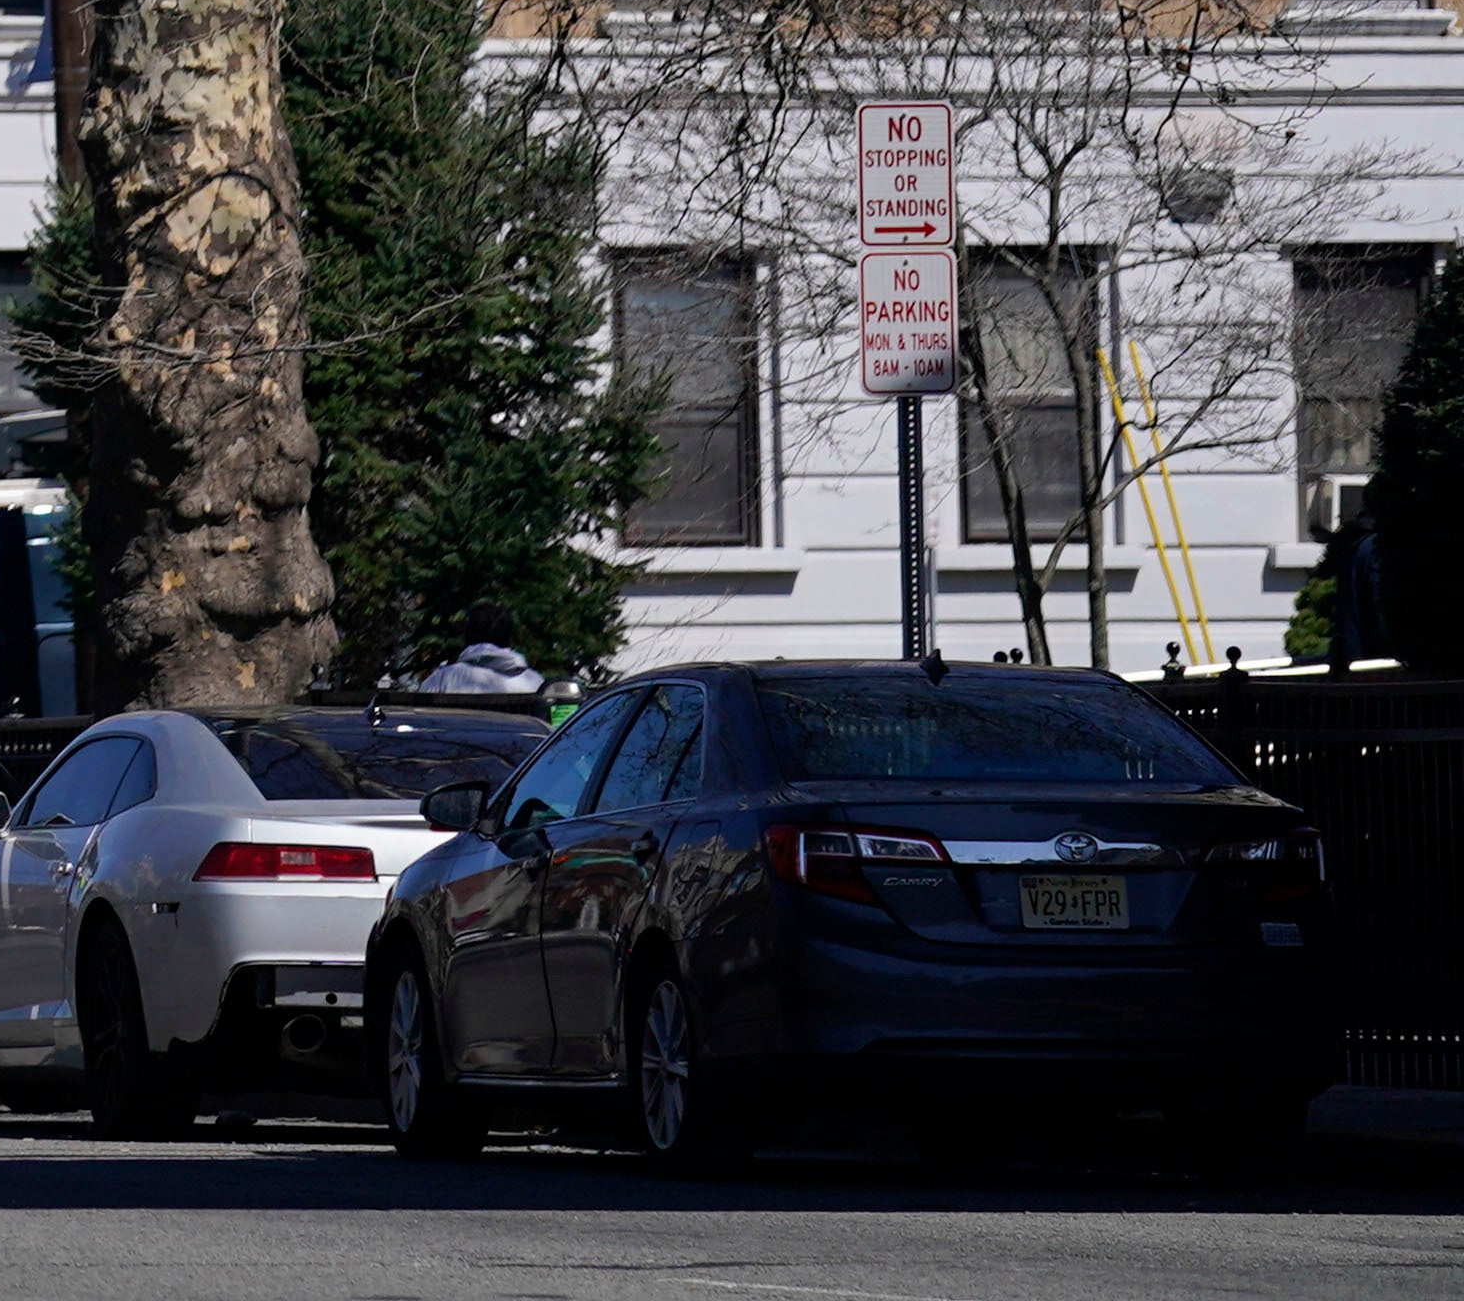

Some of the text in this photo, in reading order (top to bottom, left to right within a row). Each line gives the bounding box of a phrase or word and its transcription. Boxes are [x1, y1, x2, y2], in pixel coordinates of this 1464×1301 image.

[888, 116, 922, 142] NO
[865, 149, 947, 168] STOPPING
[894, 175, 917, 192] OR
[866, 199, 947, 217] STANDING
[894, 269, 920, 291] NO
[866, 301, 949, 323] PARKING
[898, 333, 906, 350] &
[873, 359, 899, 377] 8AM
[914, 358, 944, 377] 10AM
[883, 876, 943, 887] CAMRY
[1028, 889, 1121, 917] V29 FPR
